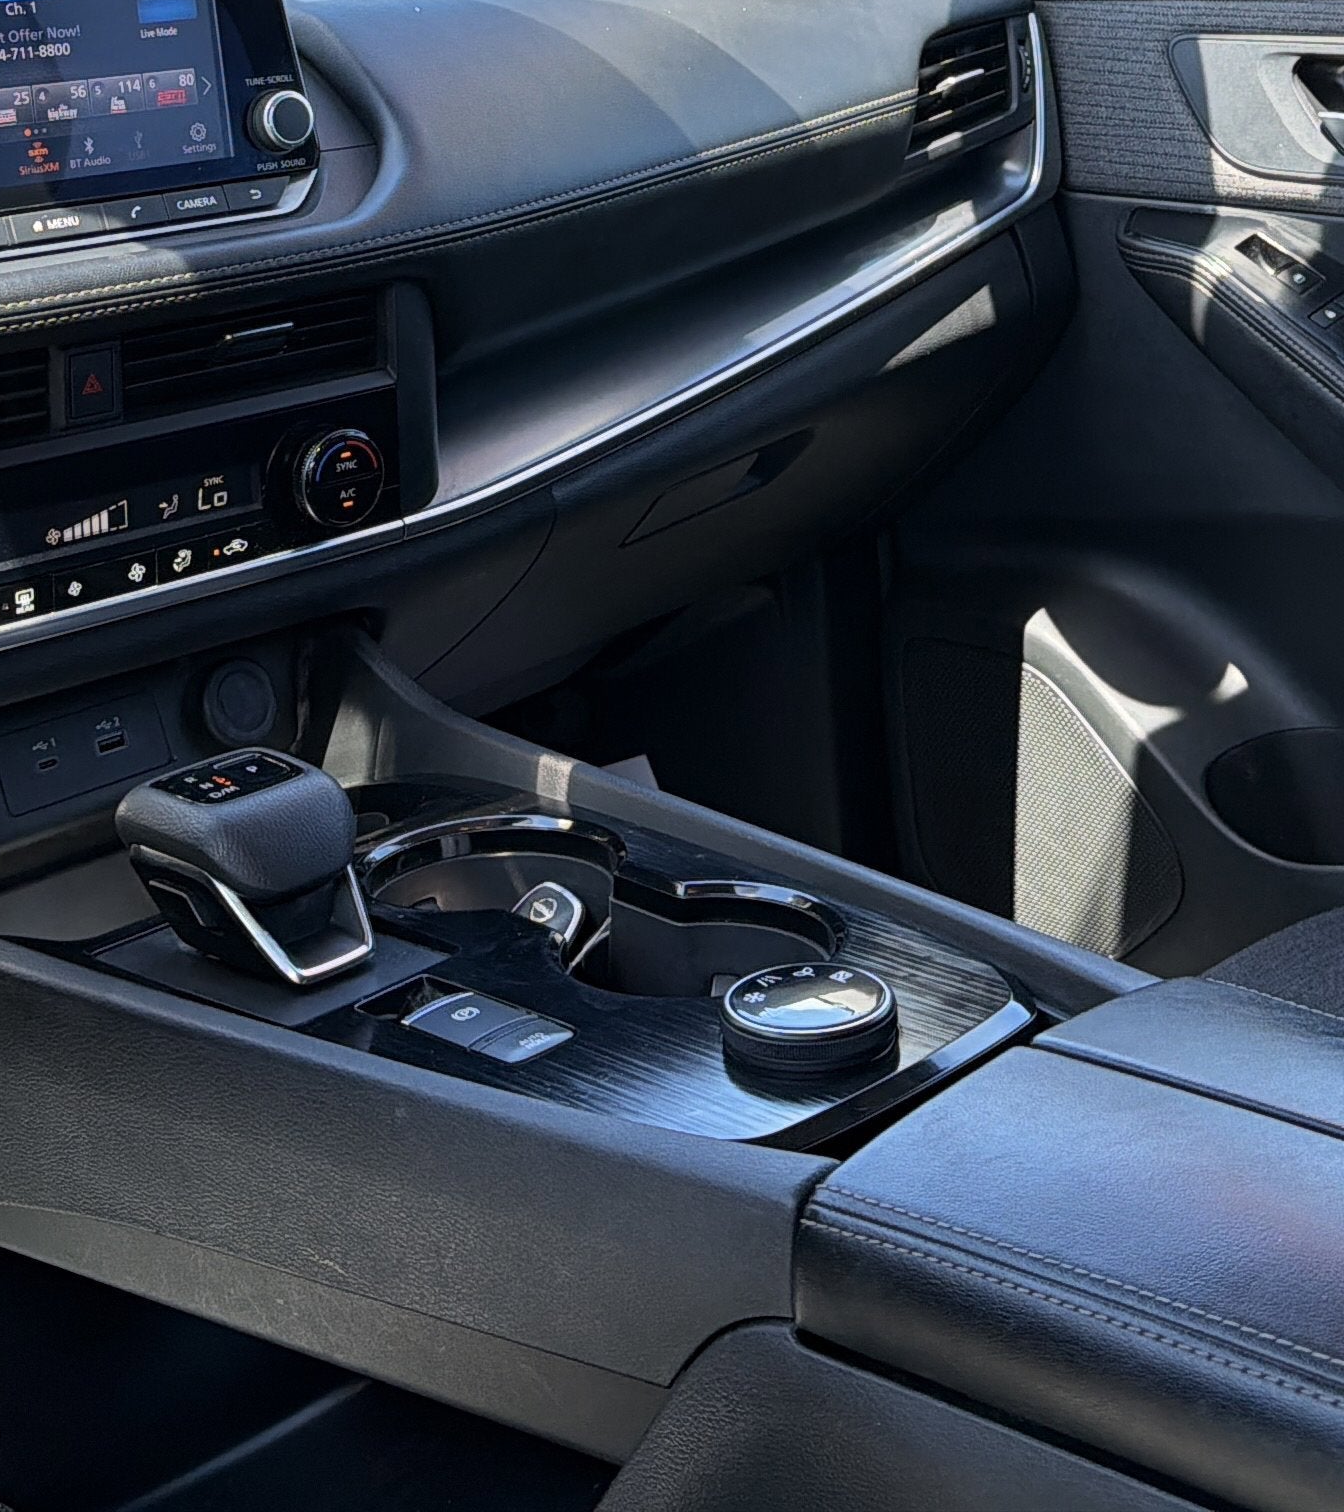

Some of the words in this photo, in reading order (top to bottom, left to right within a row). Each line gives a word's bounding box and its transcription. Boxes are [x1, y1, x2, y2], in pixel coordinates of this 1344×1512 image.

[5, 3, 27, 16] Ch.
[30, 1, 37, 14] 1
[8, 28, 44, 43] Offer
[47, 24, 81, 39] Now!
[118, 79, 141, 93] 114
[178, 73, 195, 87] 80
[13, 91, 30, 106] 25
[38, 91, 46, 101] 4
[70, 85, 87, 99] 56
[182, 139, 217, 156] Settings
[18, 161, 60, 176] SiriusXM
[69, 159, 82, 169] BT
[83, 155, 112, 168] Audio
[176, 195, 218, 211] CAMERA
[46, 215, 81, 231] MENU
[336, 459, 358, 473] SYNC
[203, 475, 224, 487] SYNC
[339, 488, 357, 500] A/C
